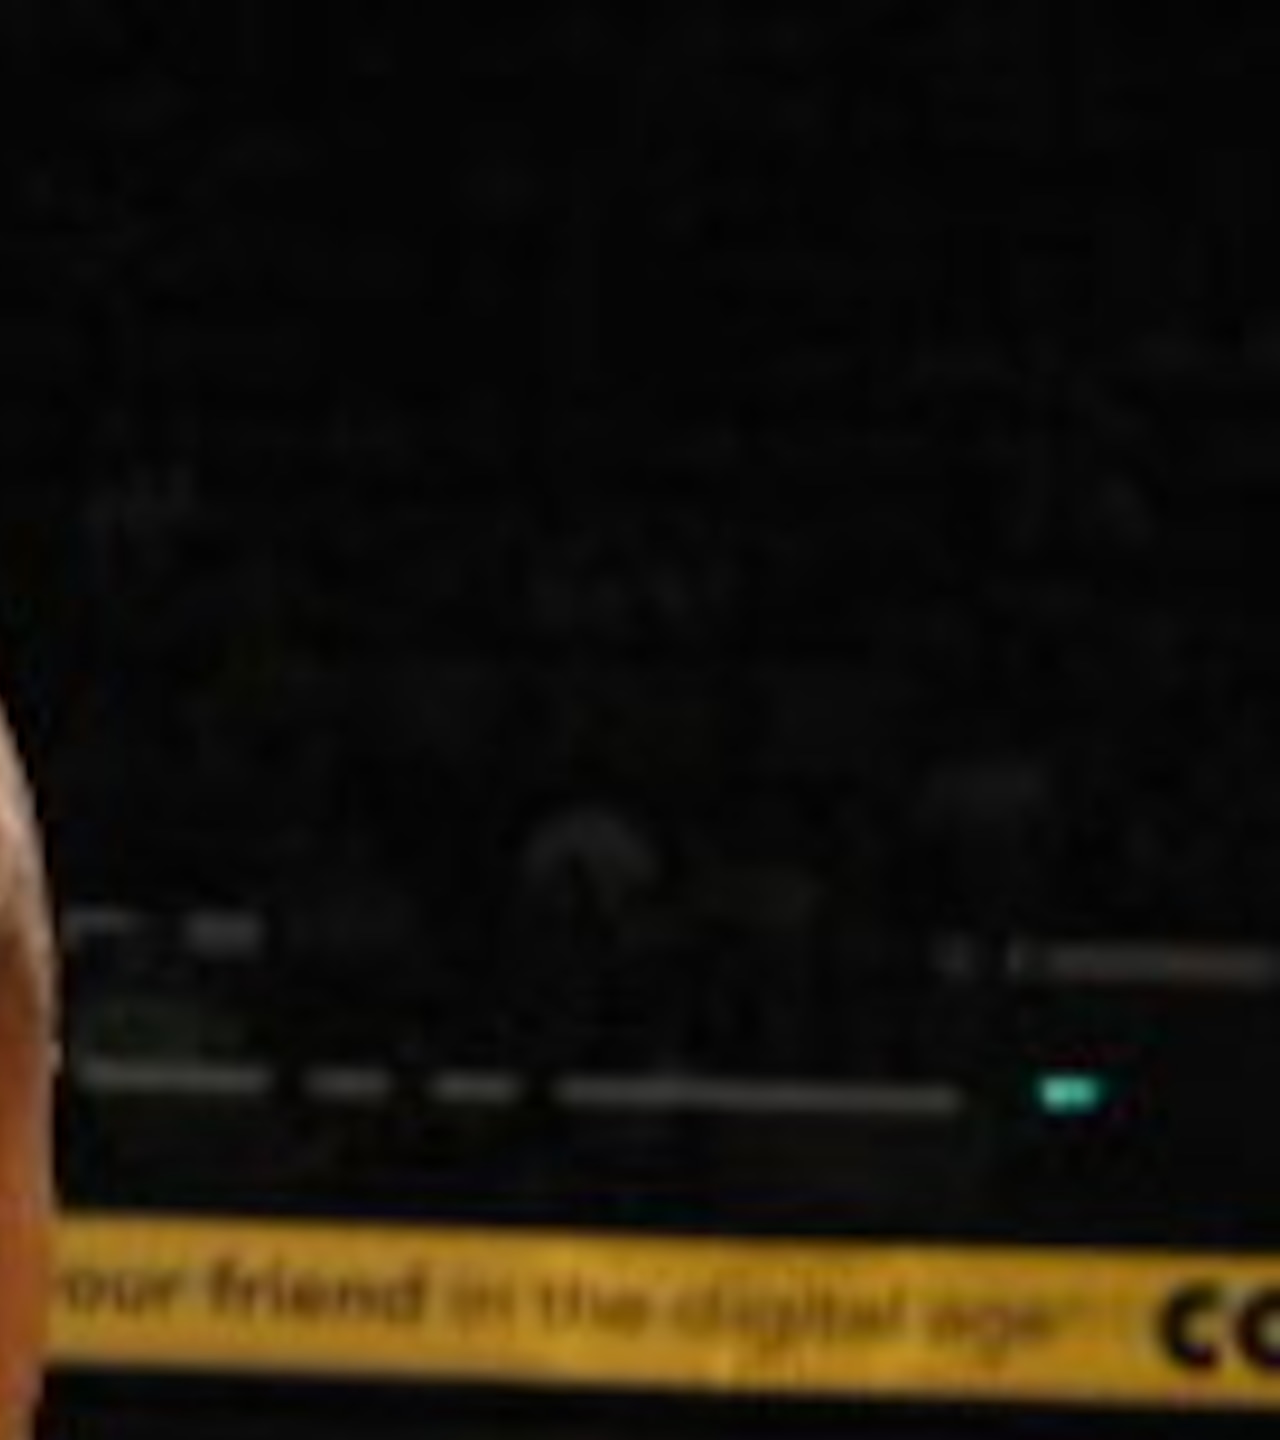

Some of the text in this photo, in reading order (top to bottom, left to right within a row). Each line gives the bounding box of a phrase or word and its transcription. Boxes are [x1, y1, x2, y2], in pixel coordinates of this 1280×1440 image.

[48, 1262, 183, 1322] our
[207, 1252, 430, 1328] friend
[537, 1264, 652, 1338] the
[673, 1268, 906, 1360] digital
